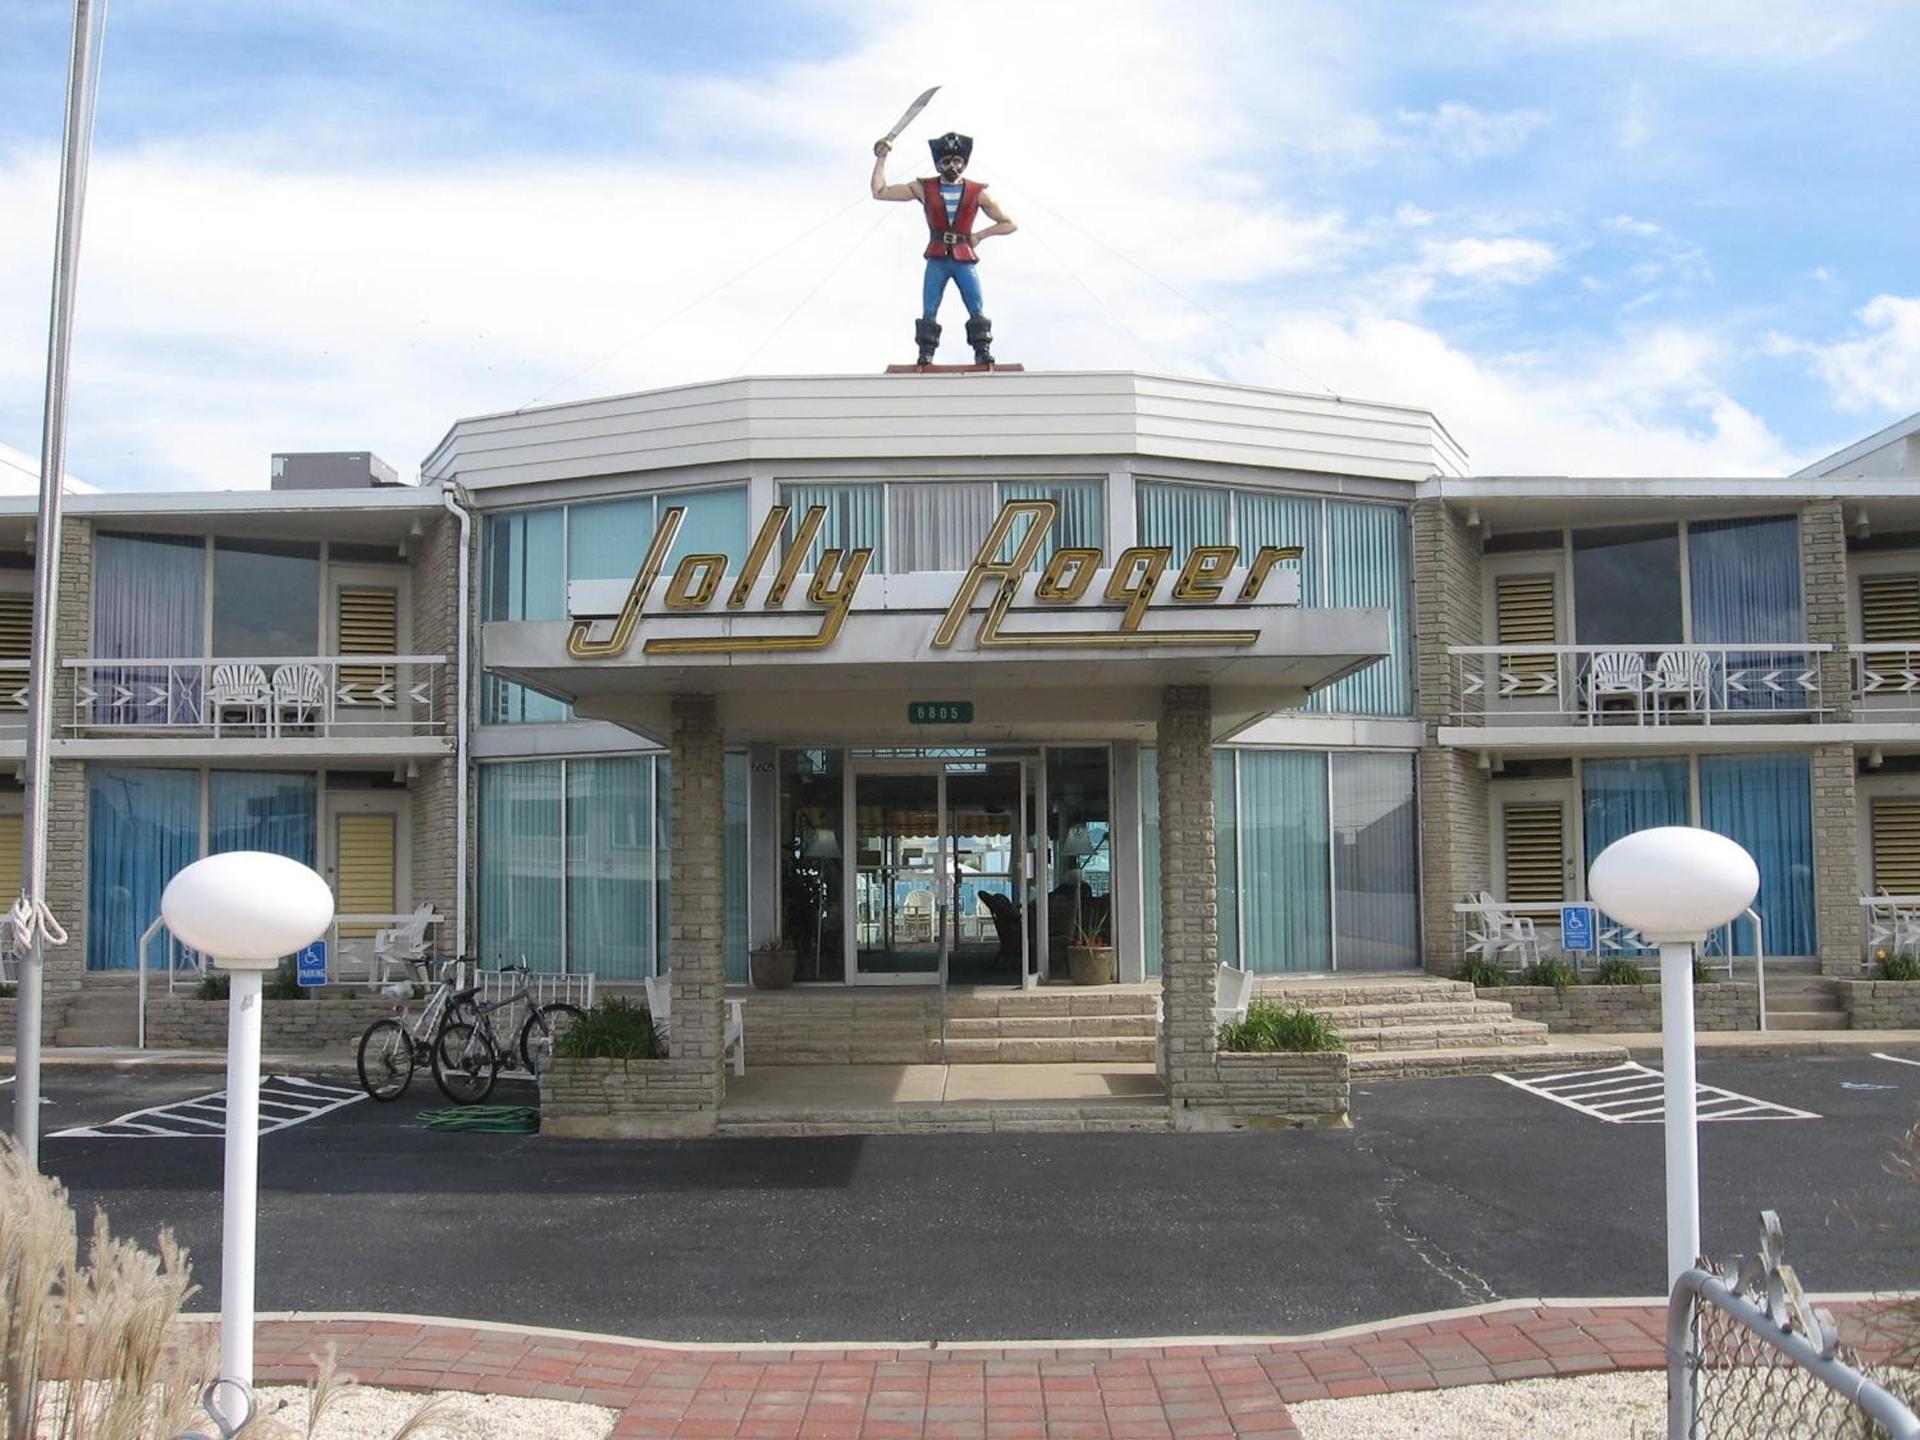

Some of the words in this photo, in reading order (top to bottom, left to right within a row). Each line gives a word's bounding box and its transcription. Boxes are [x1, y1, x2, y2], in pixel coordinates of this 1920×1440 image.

[566, 505, 874, 659] Jolly
[930, 499, 1303, 650] Roger
[917, 706, 958, 719] 6805
